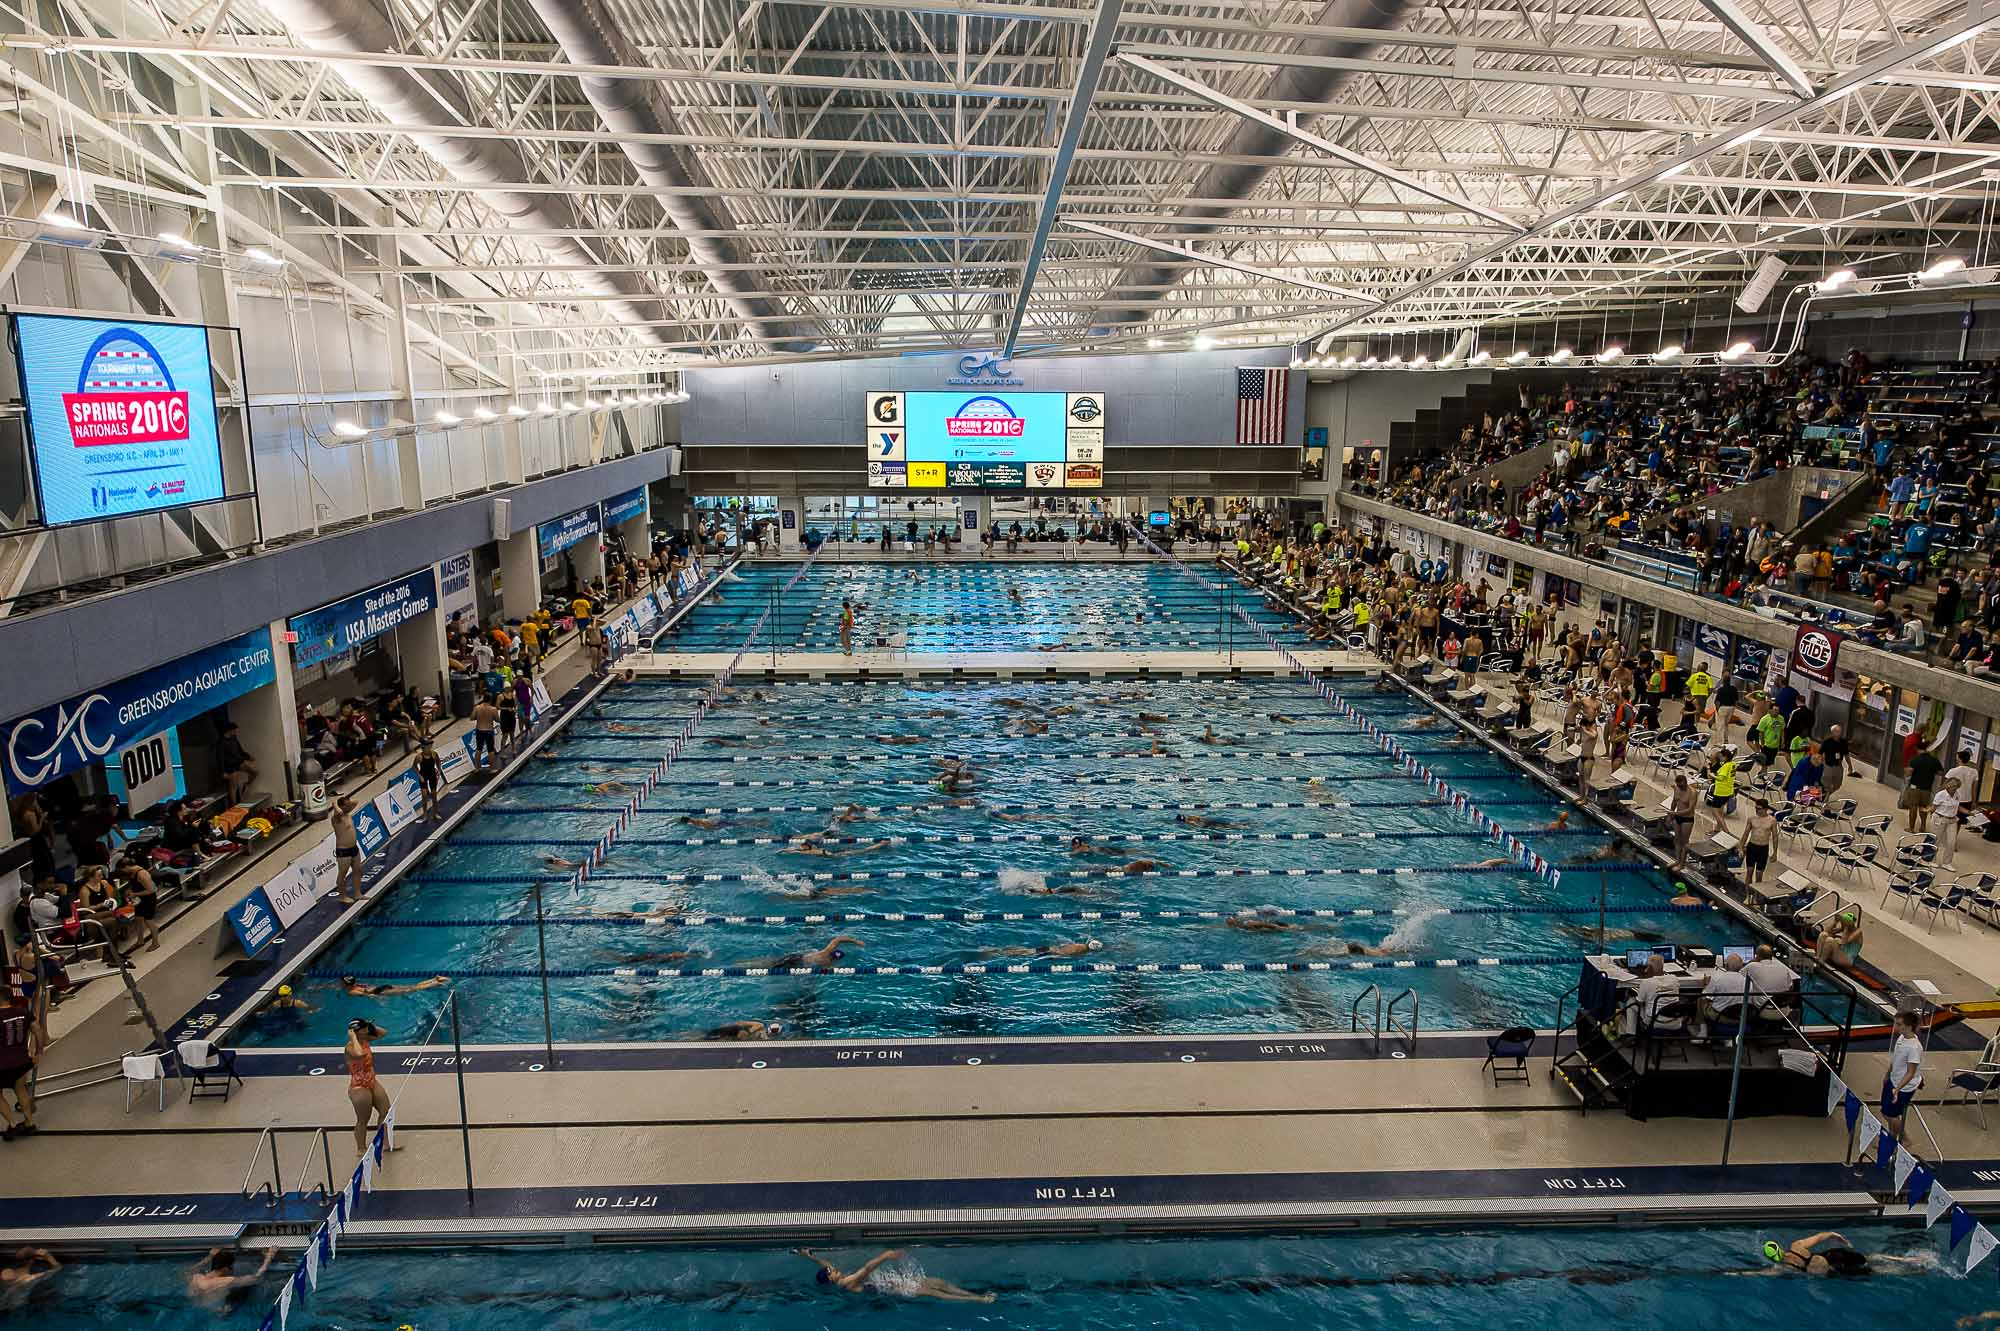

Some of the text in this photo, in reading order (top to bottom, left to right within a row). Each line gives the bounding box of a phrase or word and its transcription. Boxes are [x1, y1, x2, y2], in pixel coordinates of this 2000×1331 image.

[72, 401, 127, 423] SPRING
[129, 397, 187, 434] 2016
[75, 422, 129, 438] NATIONALS
[950, 420, 982, 429] SPRING
[948, 470, 982, 478] CAROLINA
[441, 554, 470, 578] MASTERS
[364, 584, 411, 614] Site of the 2016
[345, 618, 367, 645] USA
[367, 609, 401, 636] Masters
[402, 596, 429, 619] Games
[1800, 640, 1830, 661] TIDE
[1816, 638, 1828, 647] RED
[118, 648, 271, 725] GREENSBORO AQUATIC CENTER
[122, 737, 167, 790] ODD
